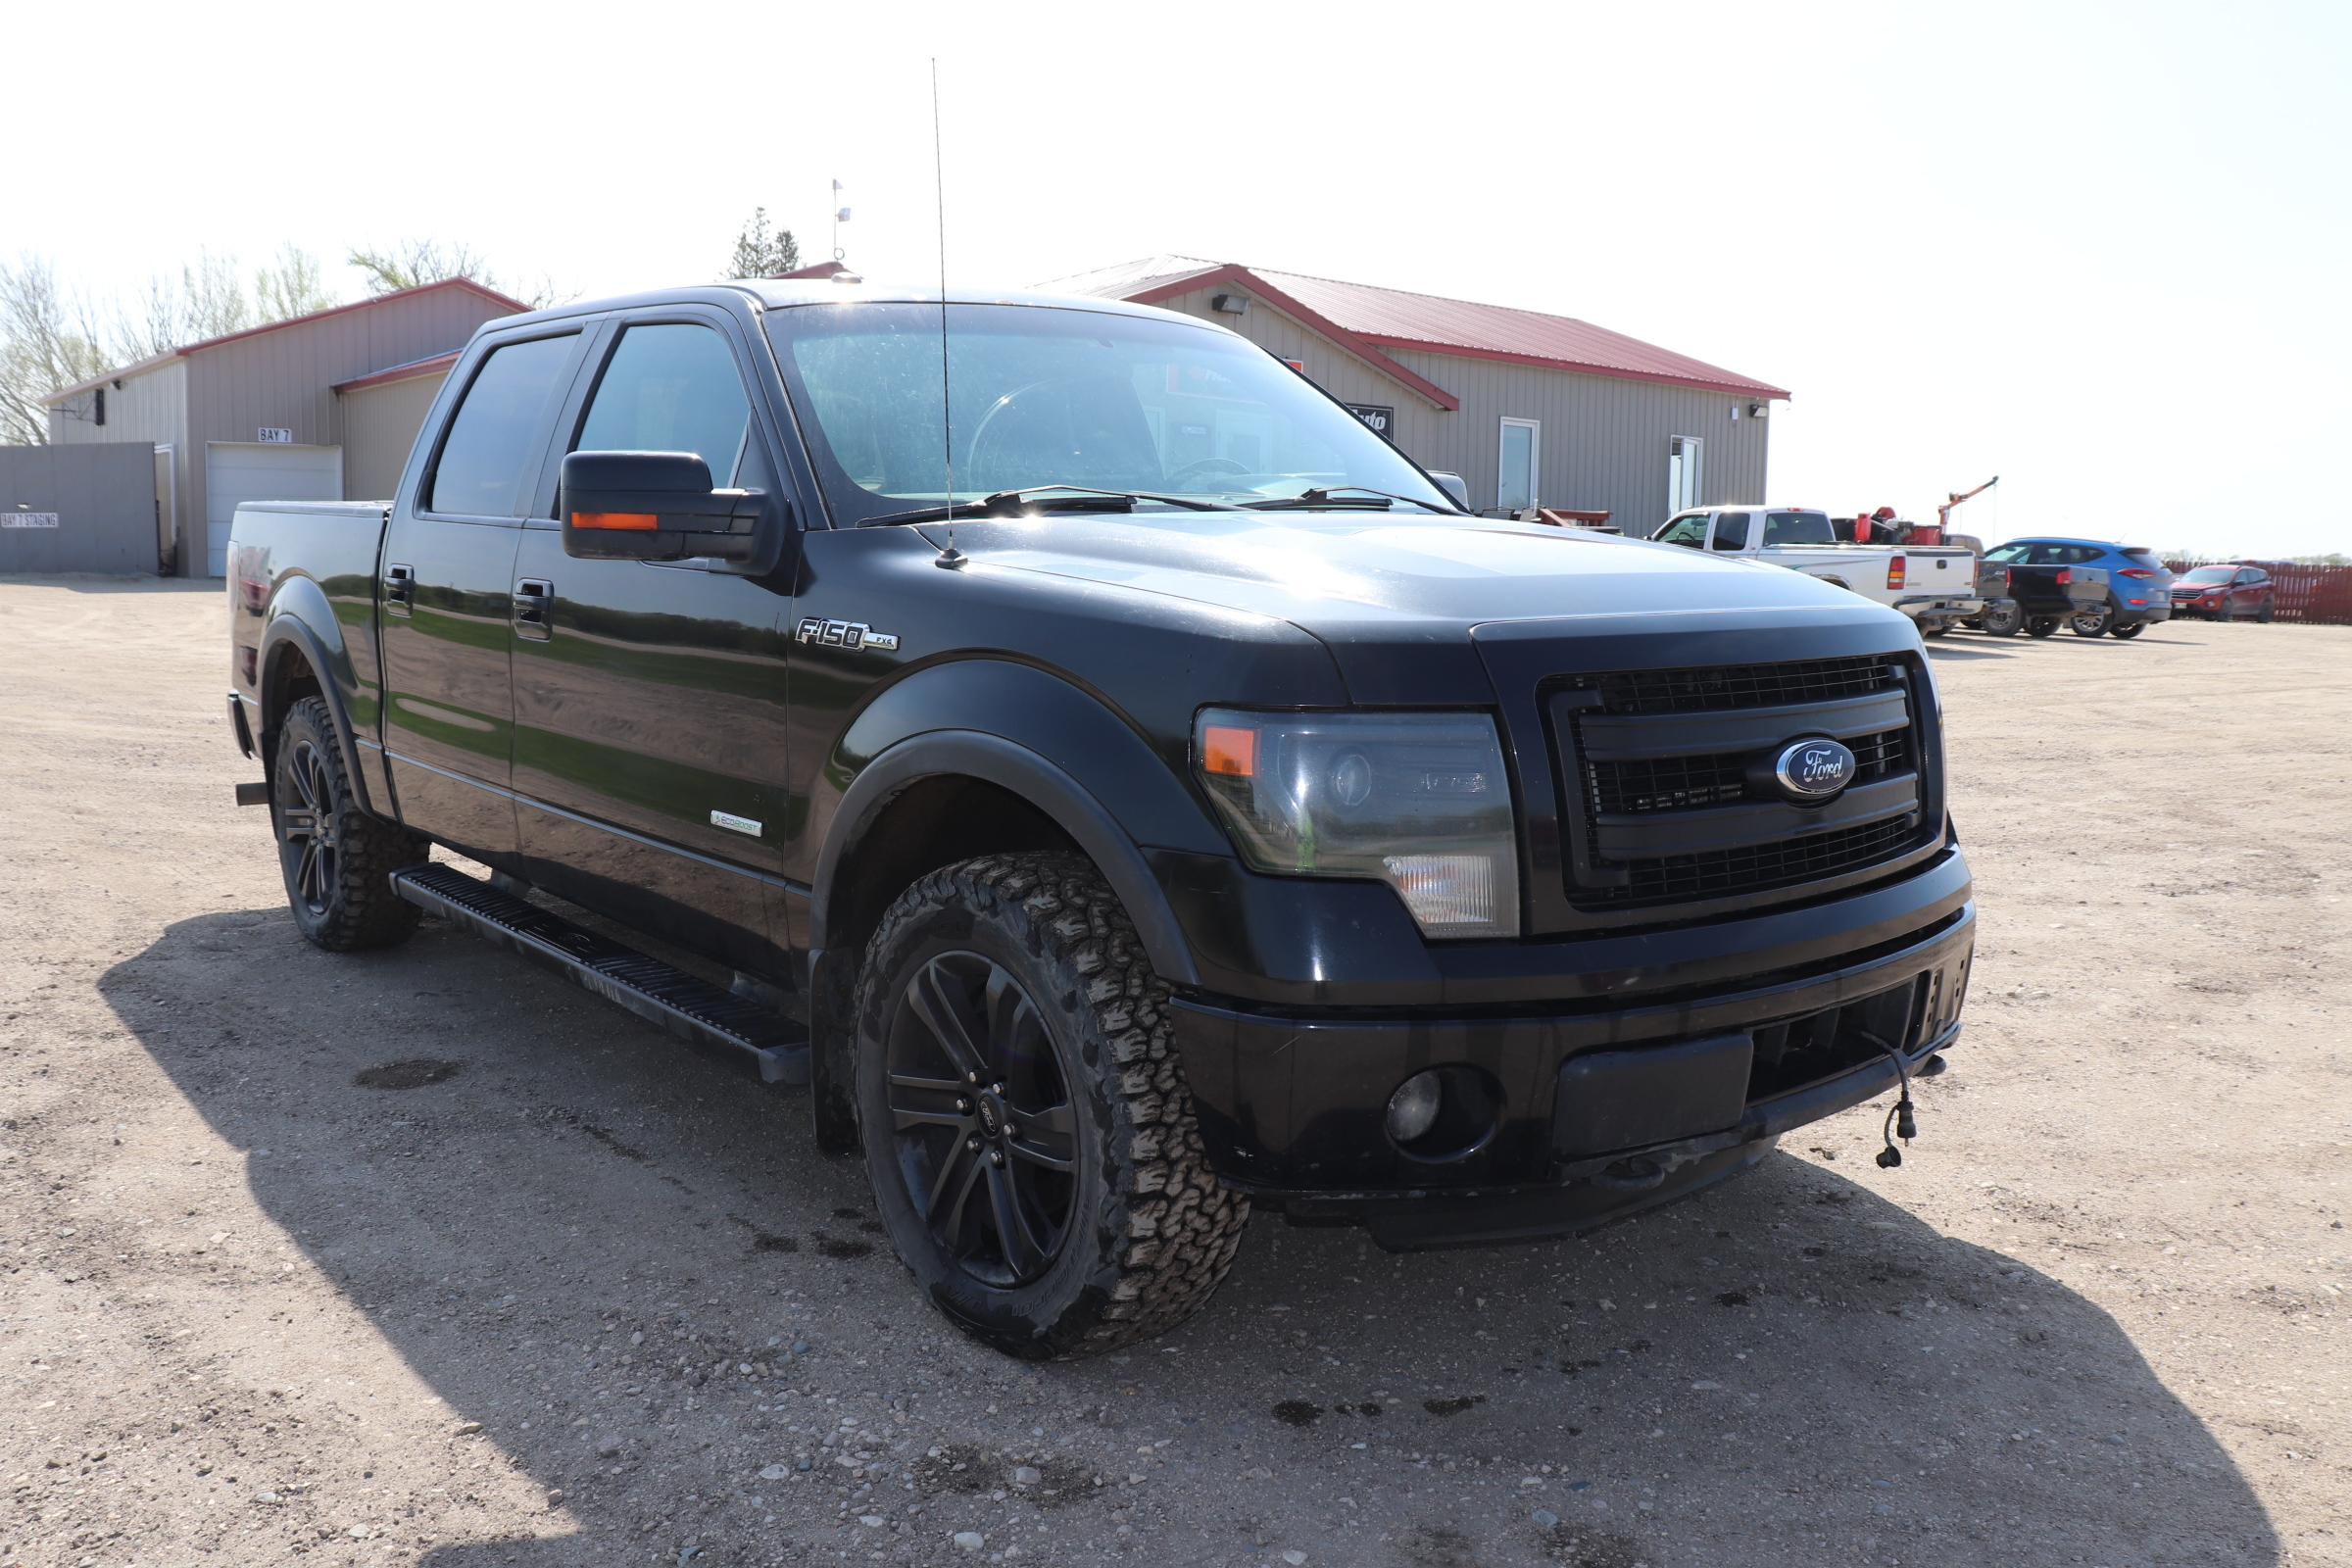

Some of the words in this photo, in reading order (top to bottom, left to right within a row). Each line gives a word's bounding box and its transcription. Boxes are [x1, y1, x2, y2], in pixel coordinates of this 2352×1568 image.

[260, 428, 279, 441] BAY
[283, 429, 289, 442] 7
[2, 514, 16, 526] BAY
[24, 514, 56, 526] STAGING
[876, 636, 894, 646] FX4
[1803, 750, 1844, 783] Ford
